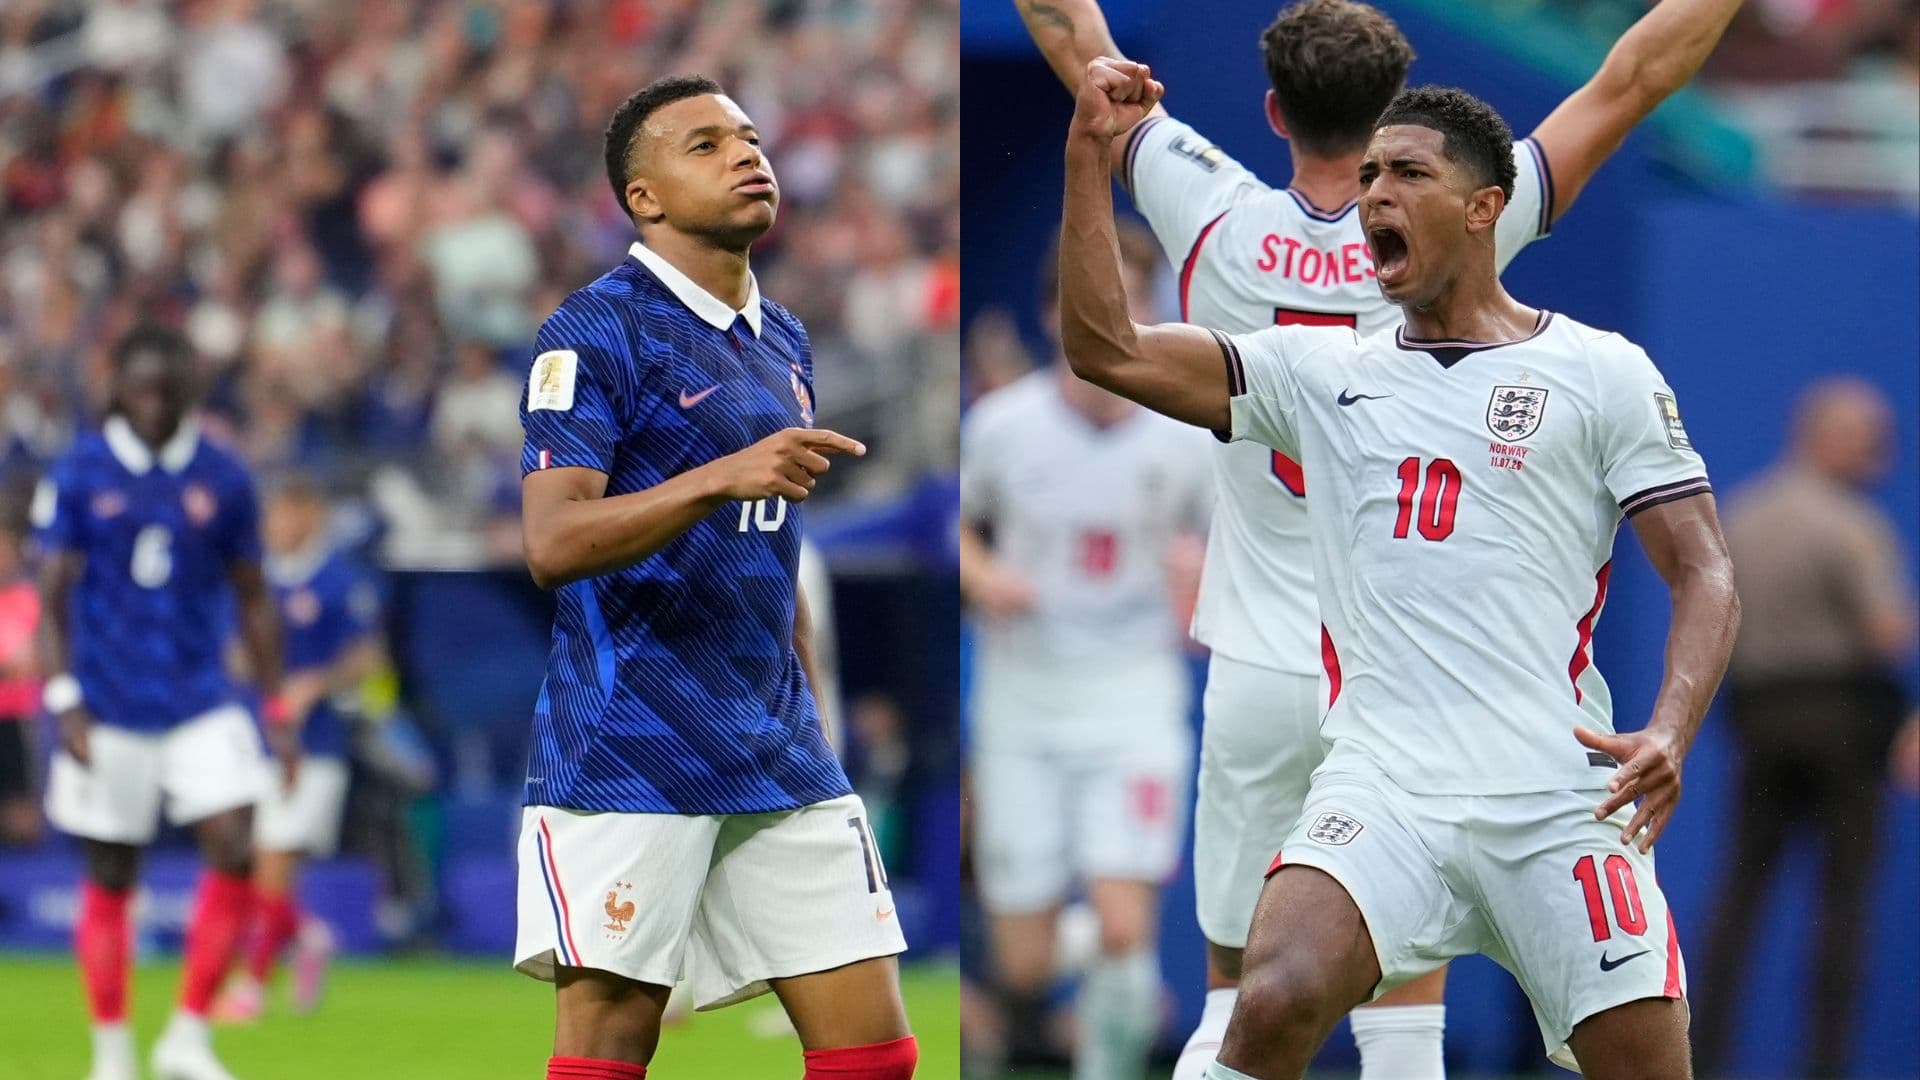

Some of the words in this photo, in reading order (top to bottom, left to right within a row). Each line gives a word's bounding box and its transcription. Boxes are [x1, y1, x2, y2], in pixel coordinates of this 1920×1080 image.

[1257, 234, 1377, 288] STONES
[1489, 442, 1528, 458] NORWAY
[1490, 456, 1523, 470] 11.07.26
[1393, 456, 1462, 542] 10
[131, 524, 173, 589] 6
[846, 816, 890, 894] 1
[1571, 854, 1649, 943] 10
